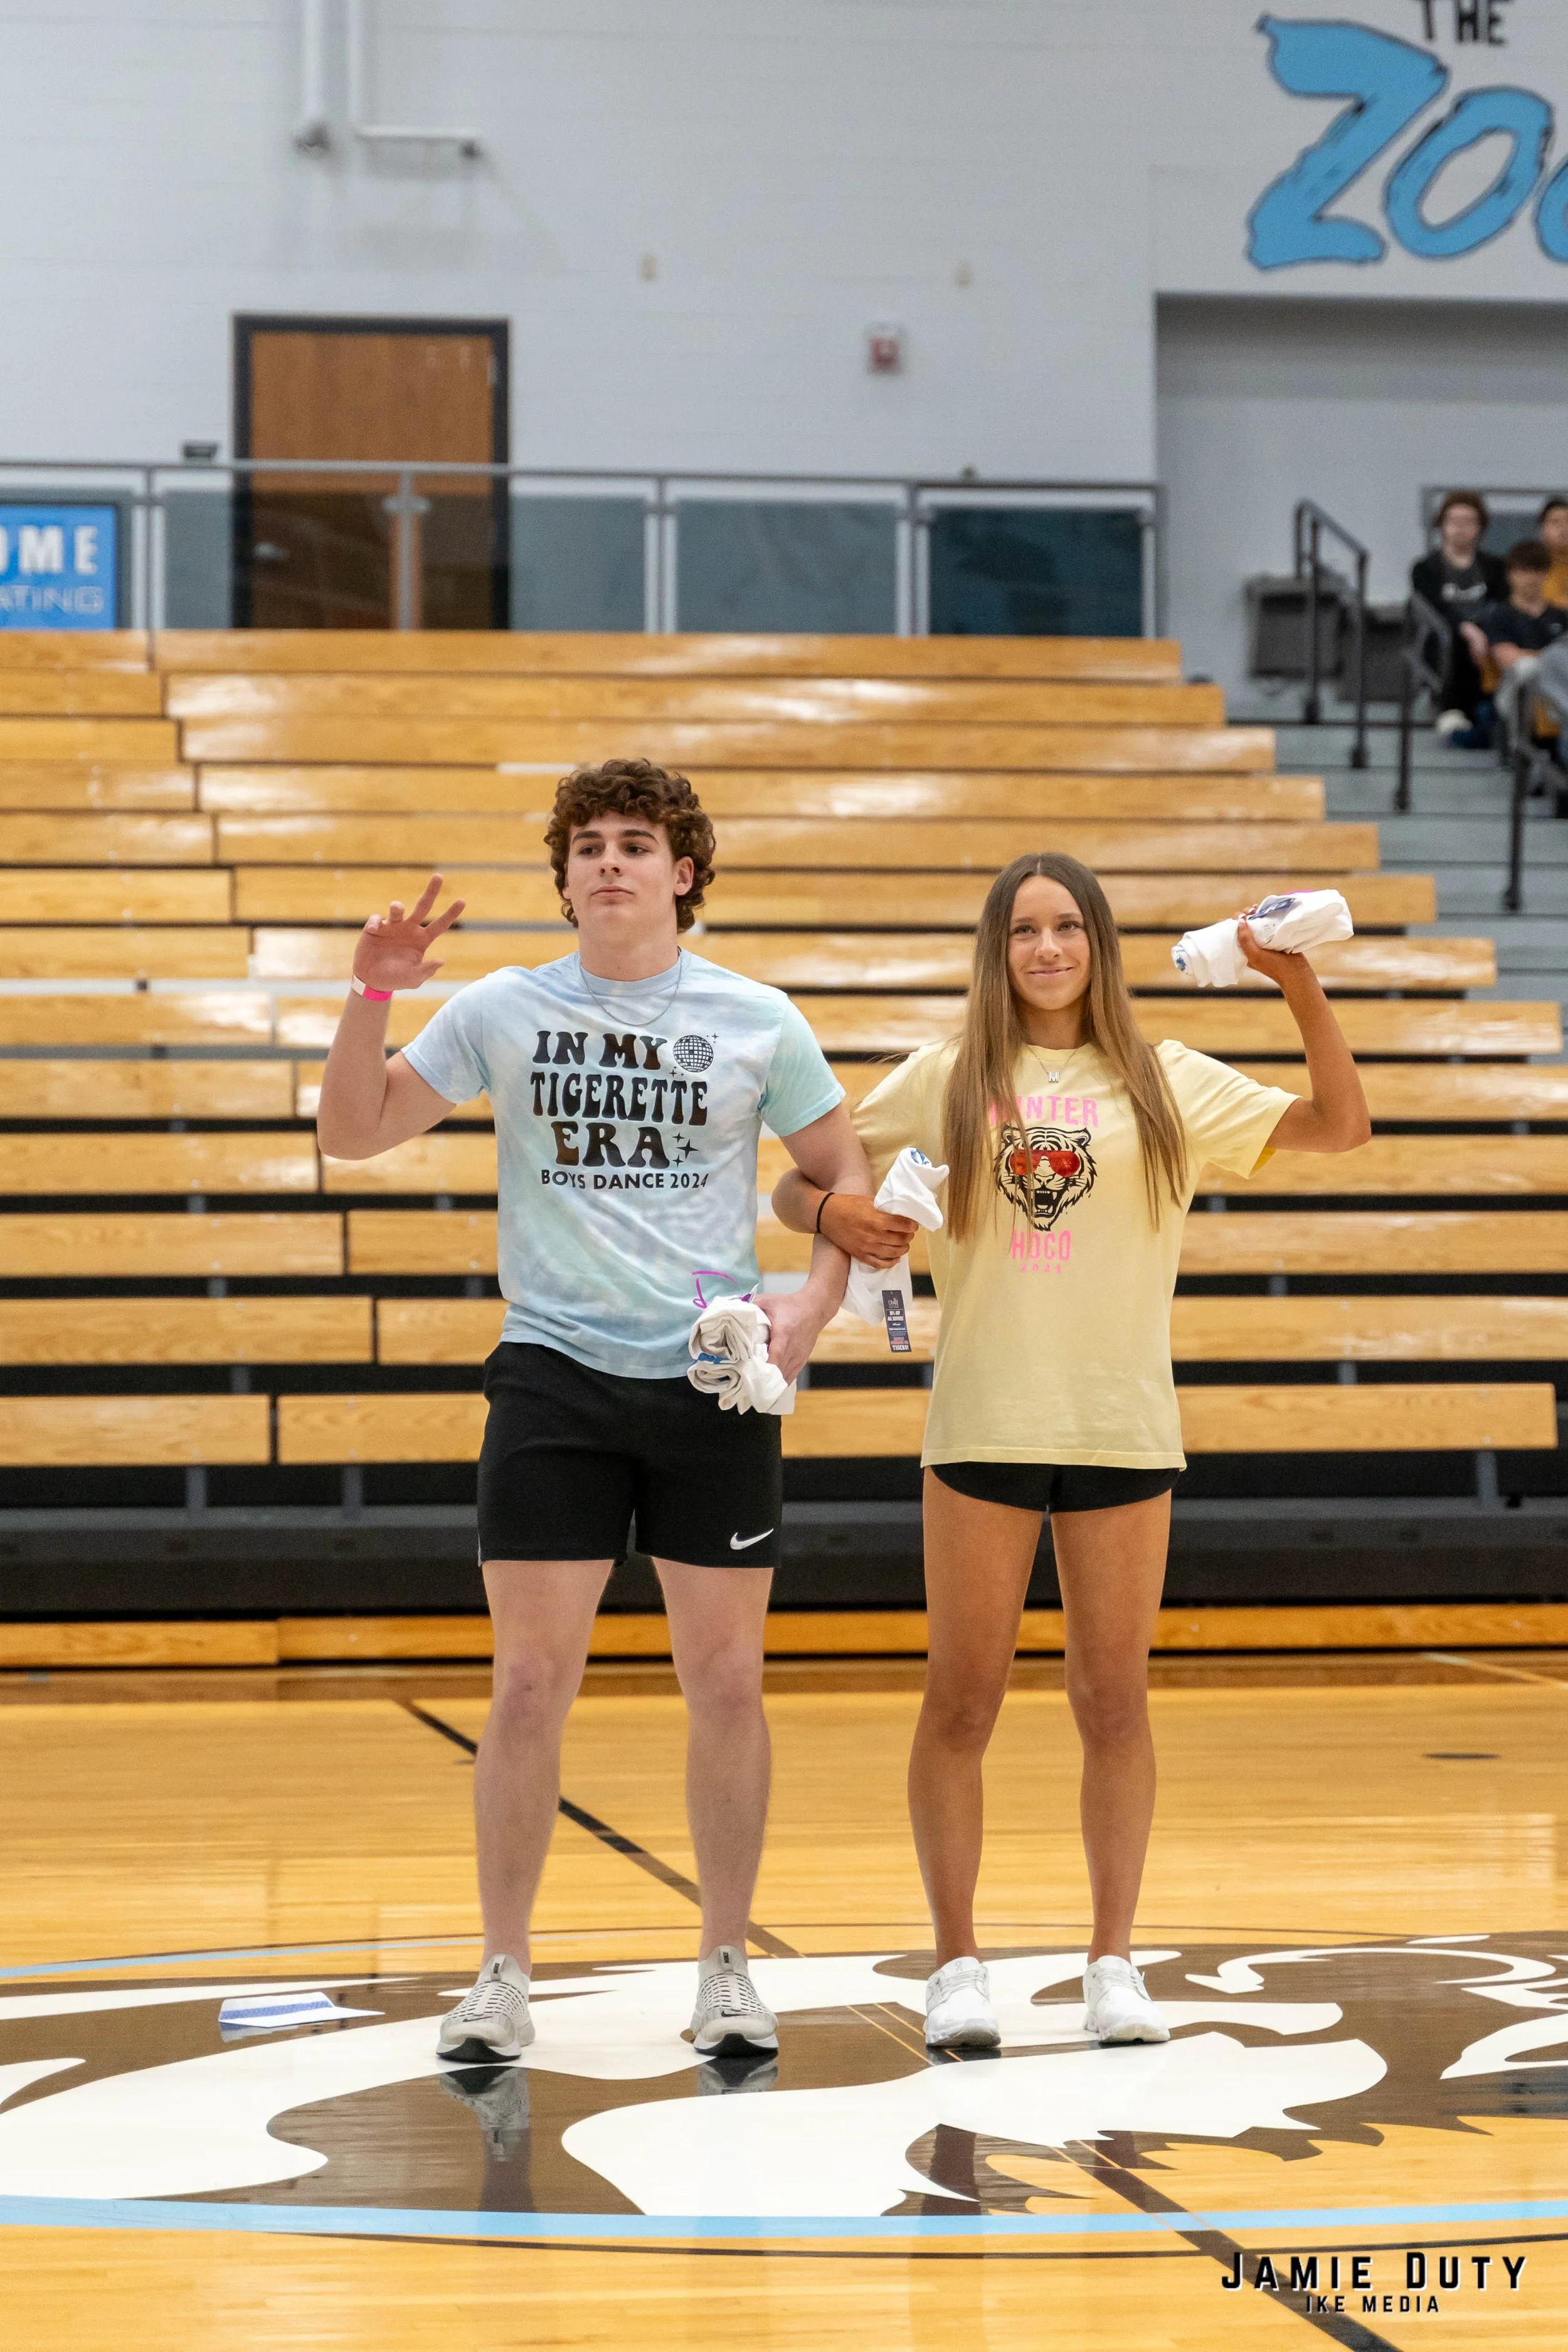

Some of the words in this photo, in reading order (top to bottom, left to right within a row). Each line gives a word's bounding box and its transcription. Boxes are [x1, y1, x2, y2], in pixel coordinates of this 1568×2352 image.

[1417, 0, 1512, 45] THE
[1245, 13, 1568, 272] ZO
[532, 1030, 588, 1066] IN
[599, 1034, 667, 1071] MY
[531, 1071, 707, 1126] TIGERETTE
[551, 1121, 670, 1169] ERA
[541, 1169, 586, 1189] BOYS
[593, 1173, 664, 1190] DANCE
[670, 1173, 709, 1189] 2024
[1011, 1229, 1071, 1261] HOCO
